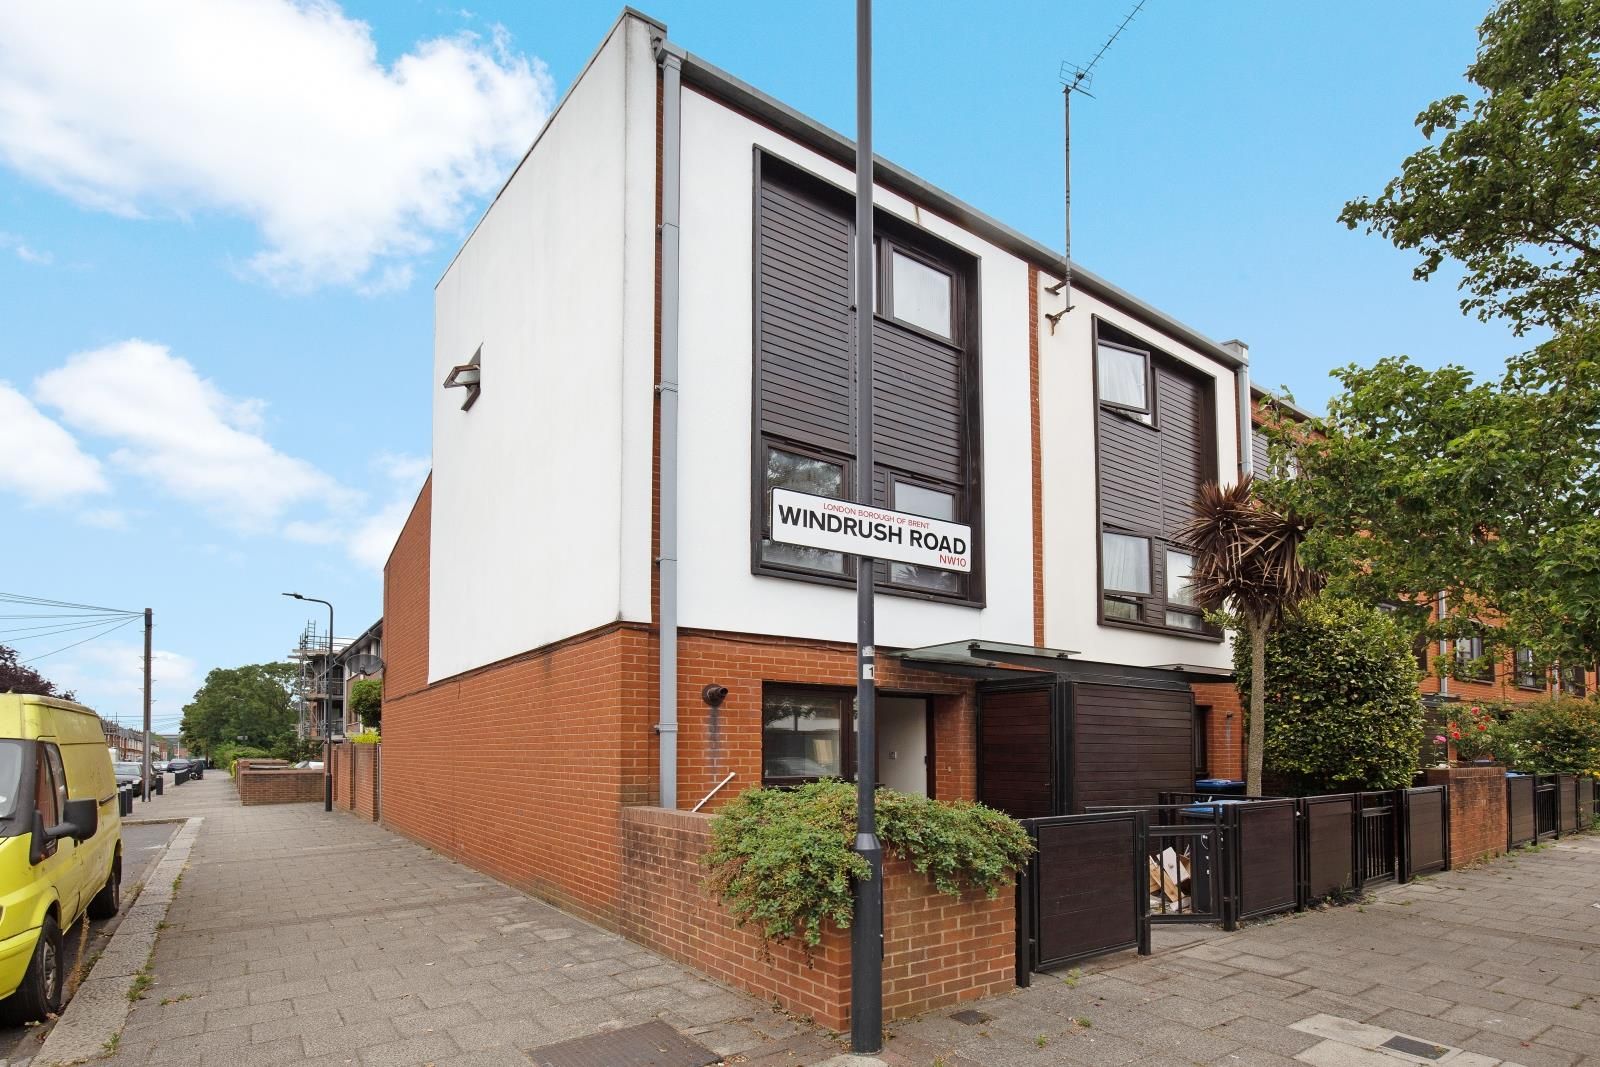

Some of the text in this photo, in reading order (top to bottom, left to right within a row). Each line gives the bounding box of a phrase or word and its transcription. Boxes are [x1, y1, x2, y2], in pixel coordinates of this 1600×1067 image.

[823, 502, 857, 515] LONDON
[857, 509, 894, 523] BOROUGH
[907, 519, 929, 529] BRENT
[778, 504, 966, 555] WINDRUSH ROAD
[939, 554, 967, 568] NW10
